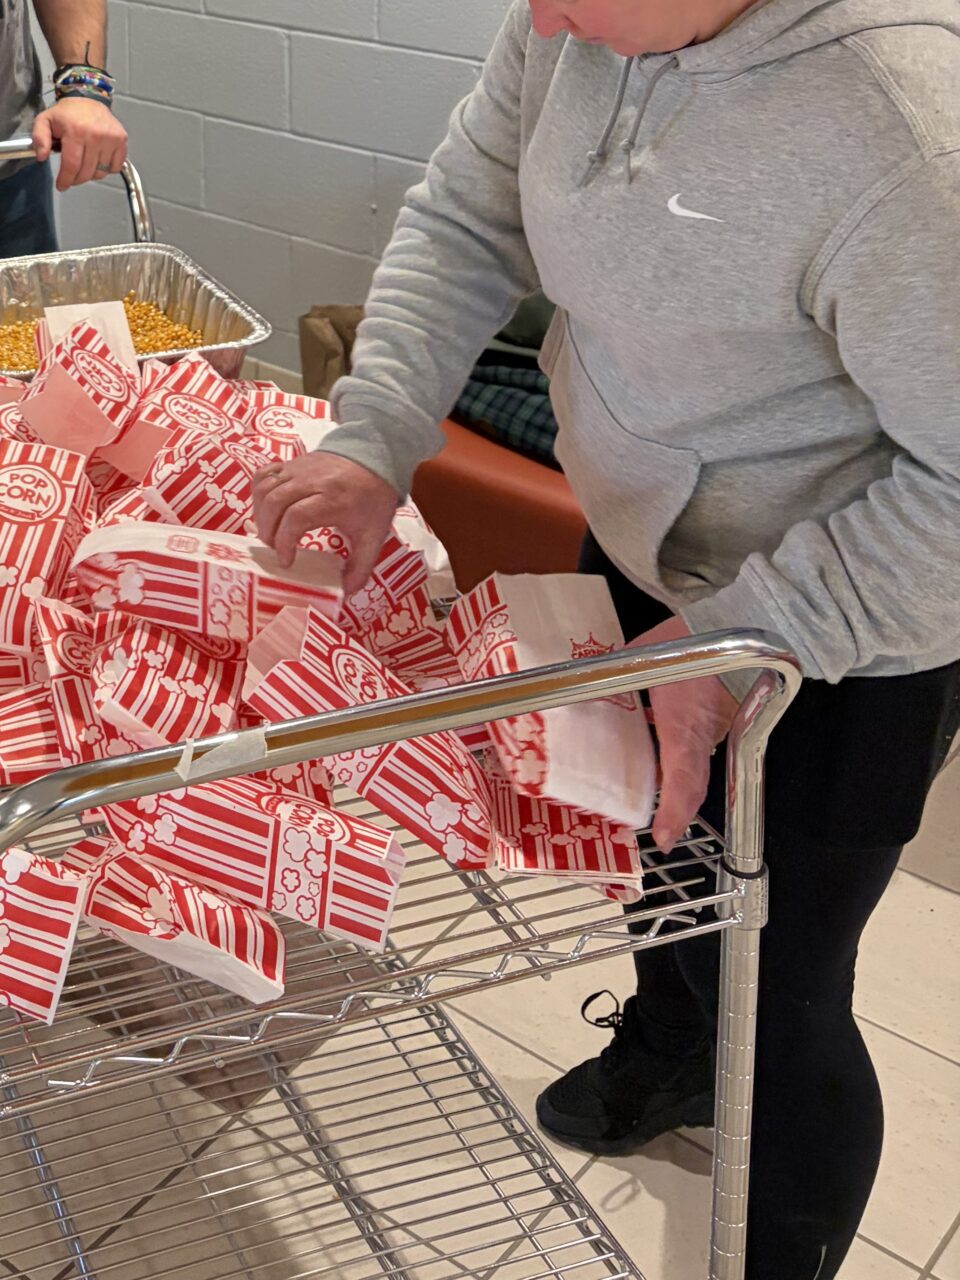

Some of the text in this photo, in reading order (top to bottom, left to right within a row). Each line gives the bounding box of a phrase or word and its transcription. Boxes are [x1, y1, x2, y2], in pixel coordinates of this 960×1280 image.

[9, 473, 49, 489] POP
[317, 526, 350, 560] POP
[343, 657, 360, 689] POP
